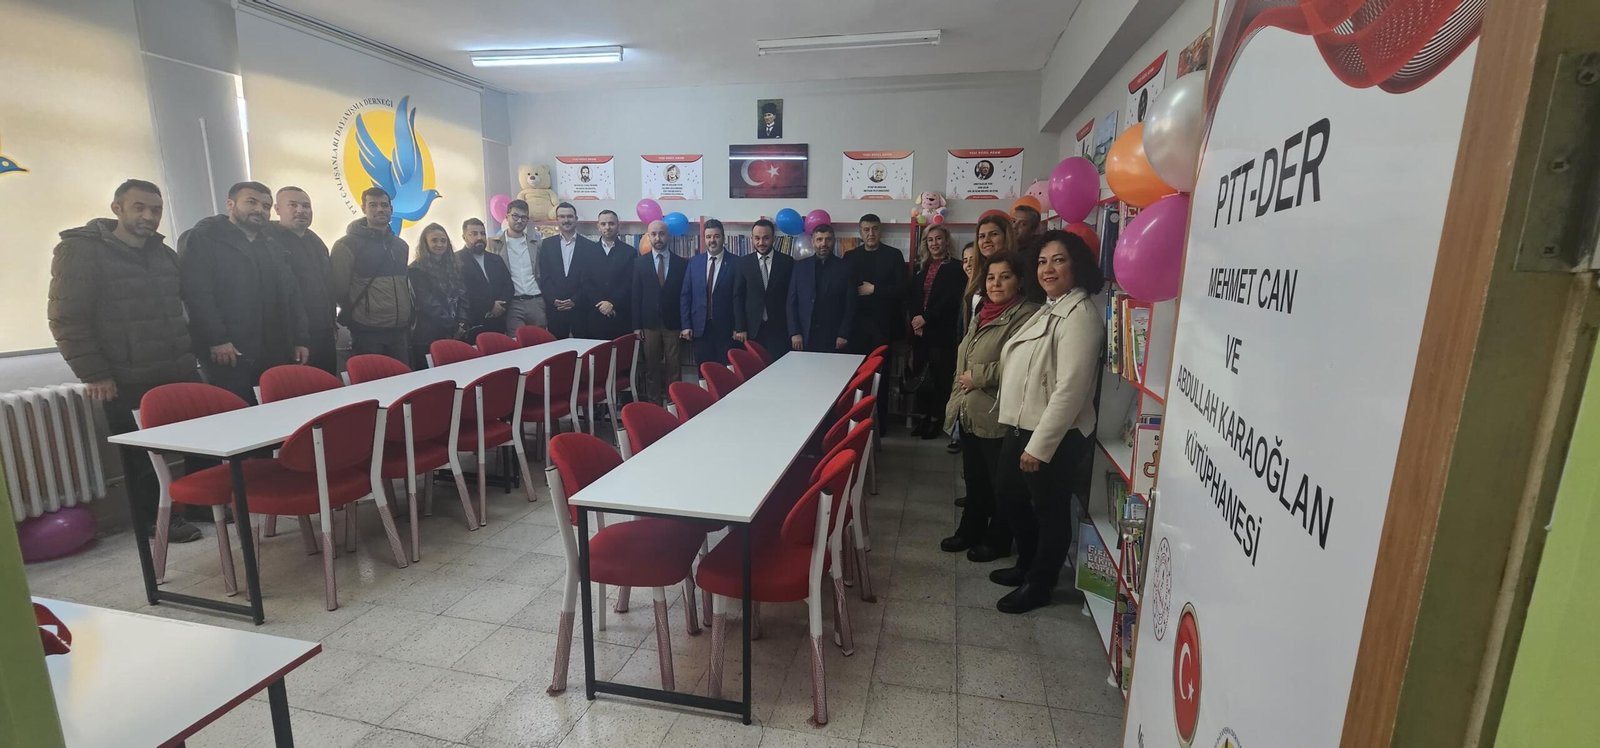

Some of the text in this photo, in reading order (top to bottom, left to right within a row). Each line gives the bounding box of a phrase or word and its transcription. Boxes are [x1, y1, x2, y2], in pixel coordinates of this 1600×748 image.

[1213, 117, 1331, 228] PTT-DER
[1208, 267, 1299, 314] MEHMET CAN
[1226, 334, 1243, 375] VE
[1176, 364, 1334, 550] ABDULLAH KARAOĞLAN
[1184, 428, 1263, 567] KÜTÜPHANESİ
